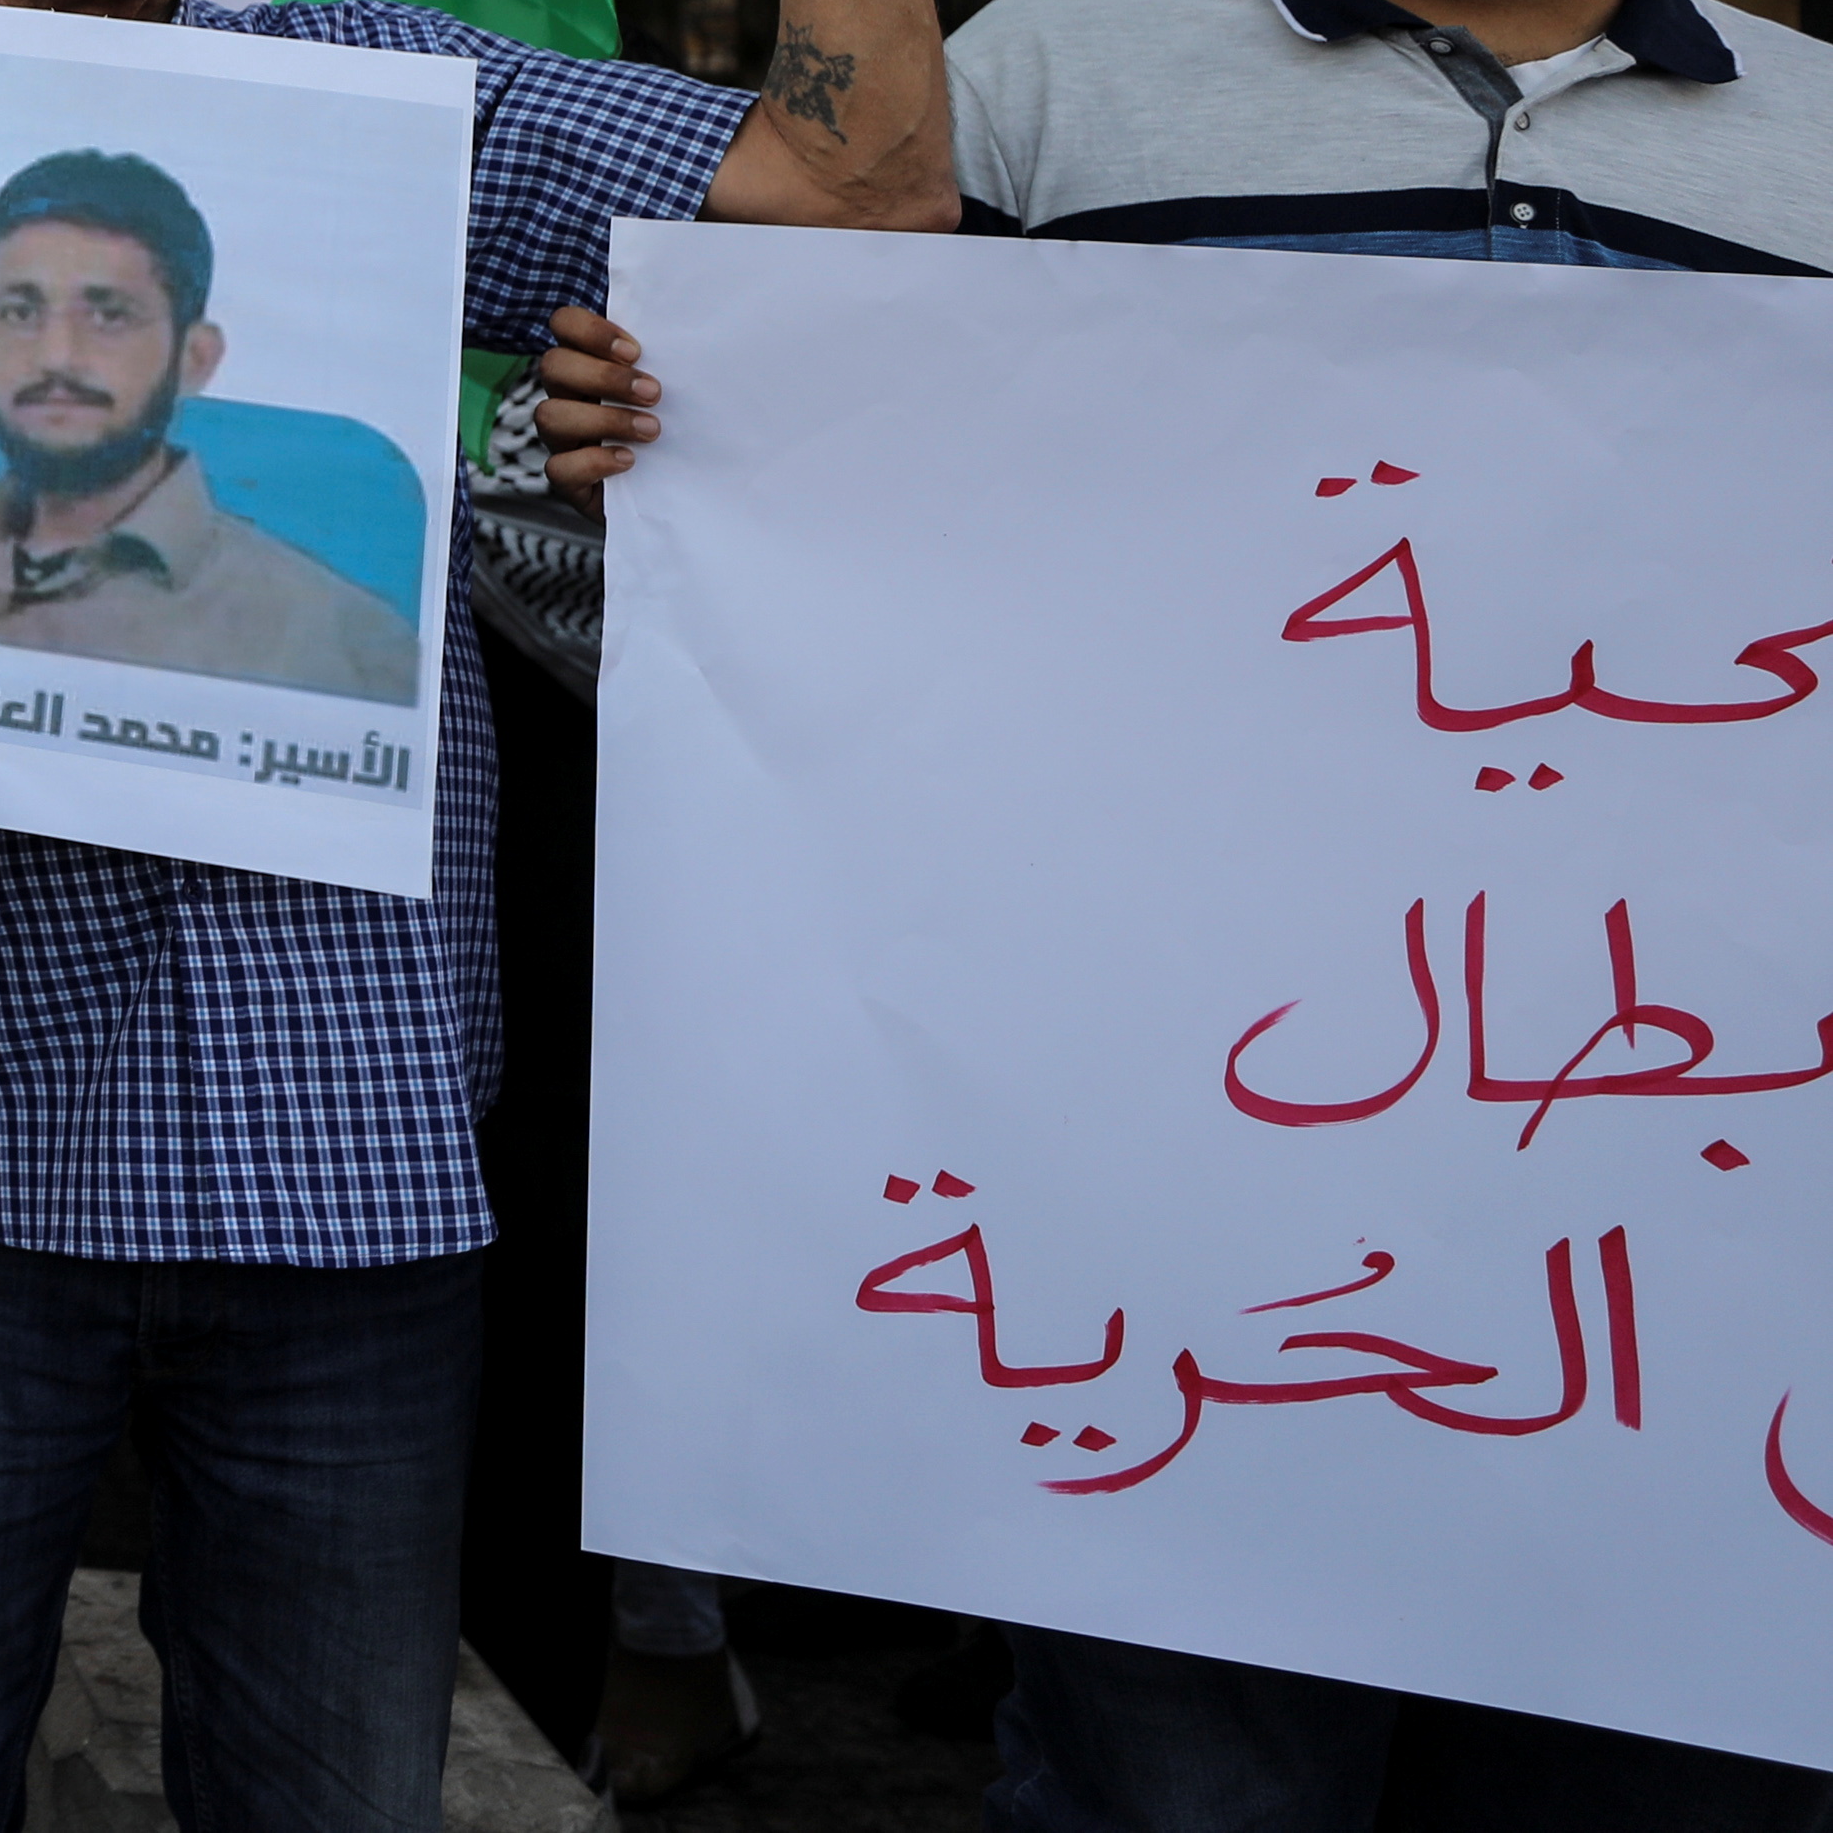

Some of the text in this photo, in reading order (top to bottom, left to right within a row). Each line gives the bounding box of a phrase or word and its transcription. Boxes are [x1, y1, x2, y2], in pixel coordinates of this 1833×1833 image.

[1280, 459, 1833, 794] حية
[76, 711, 221, 763] محمد
[237, 728, 413, 794] الأسير:
